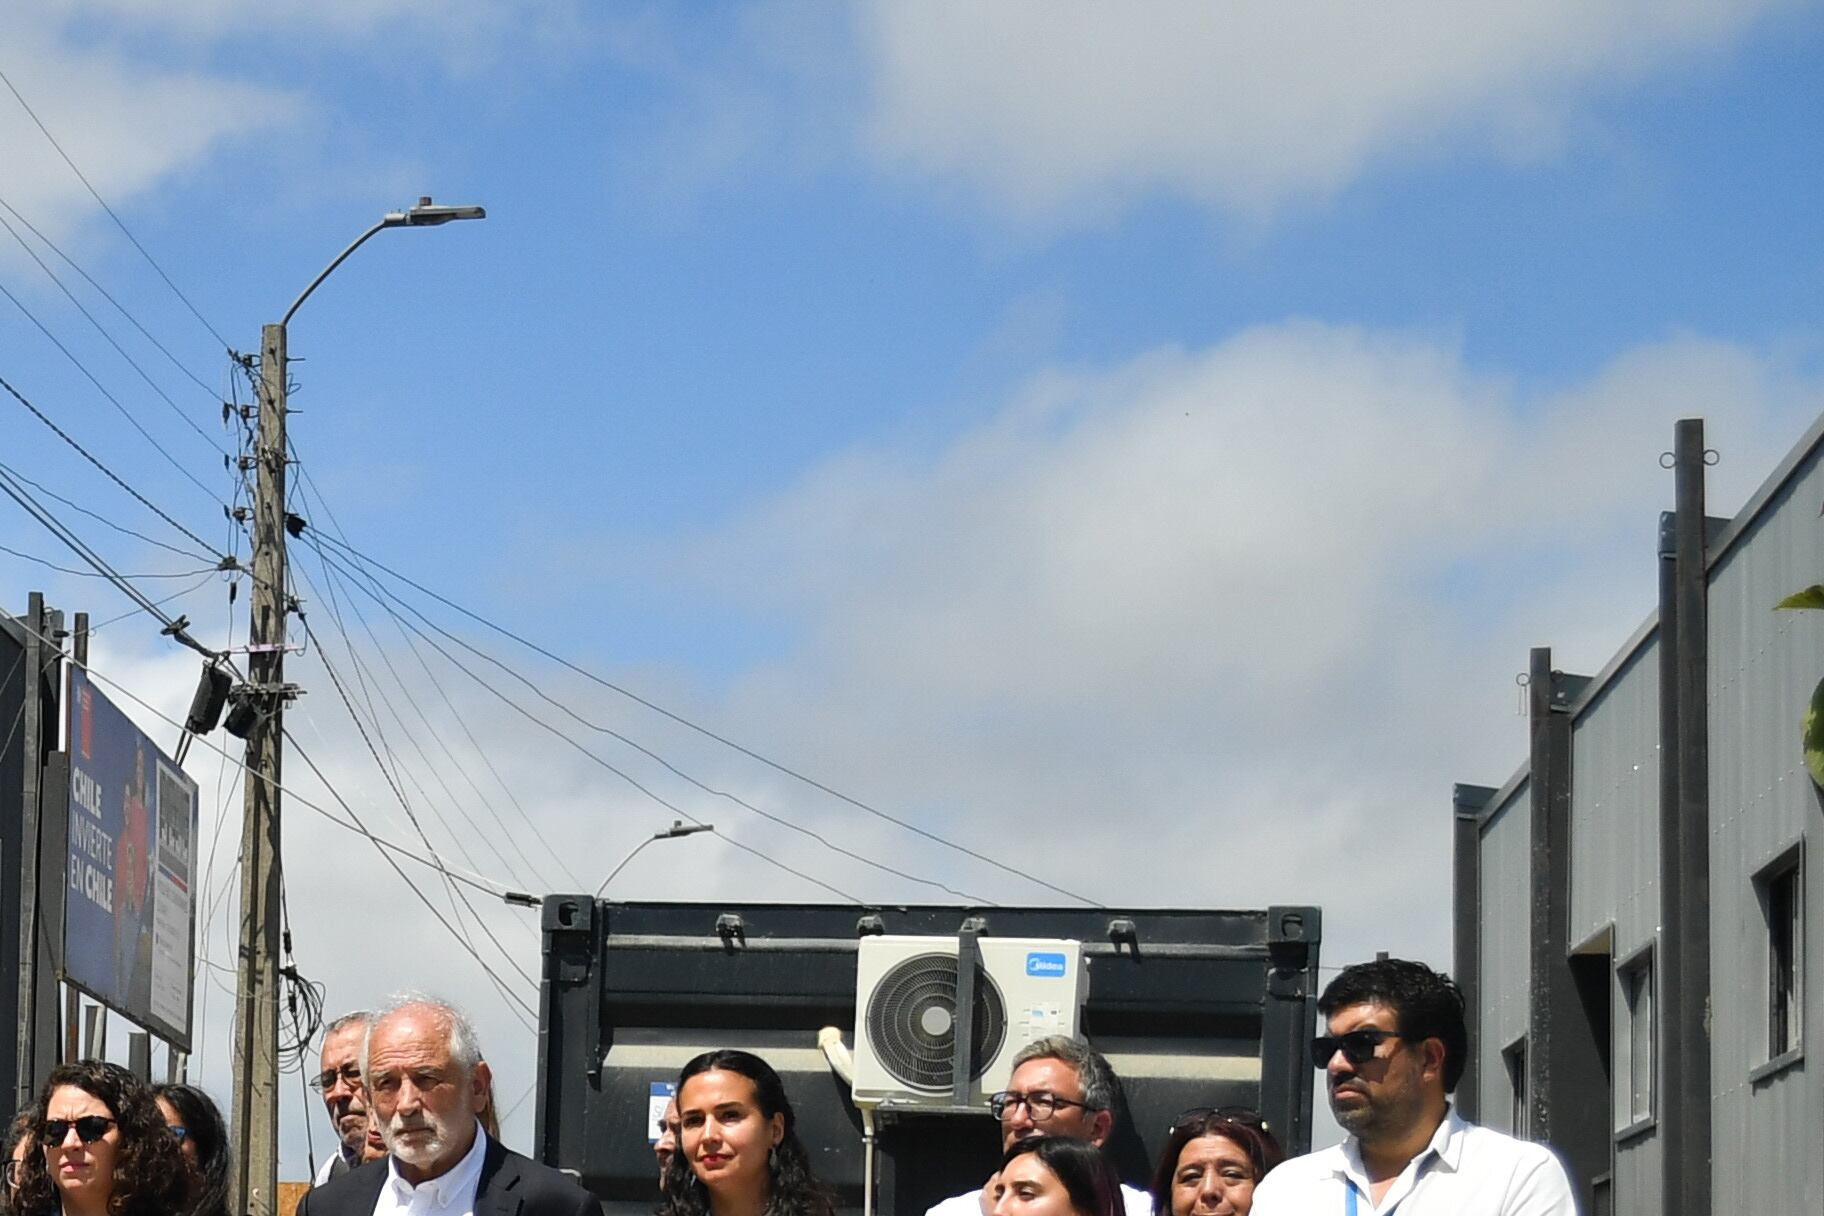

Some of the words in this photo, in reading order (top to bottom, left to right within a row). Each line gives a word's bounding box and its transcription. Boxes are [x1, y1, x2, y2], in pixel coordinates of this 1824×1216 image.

[73, 766, 102, 819] CHILE
[72, 810, 112, 870] INVIERTE
[71, 854, 84, 893] EN
[85, 864, 113, 913] CHILE
